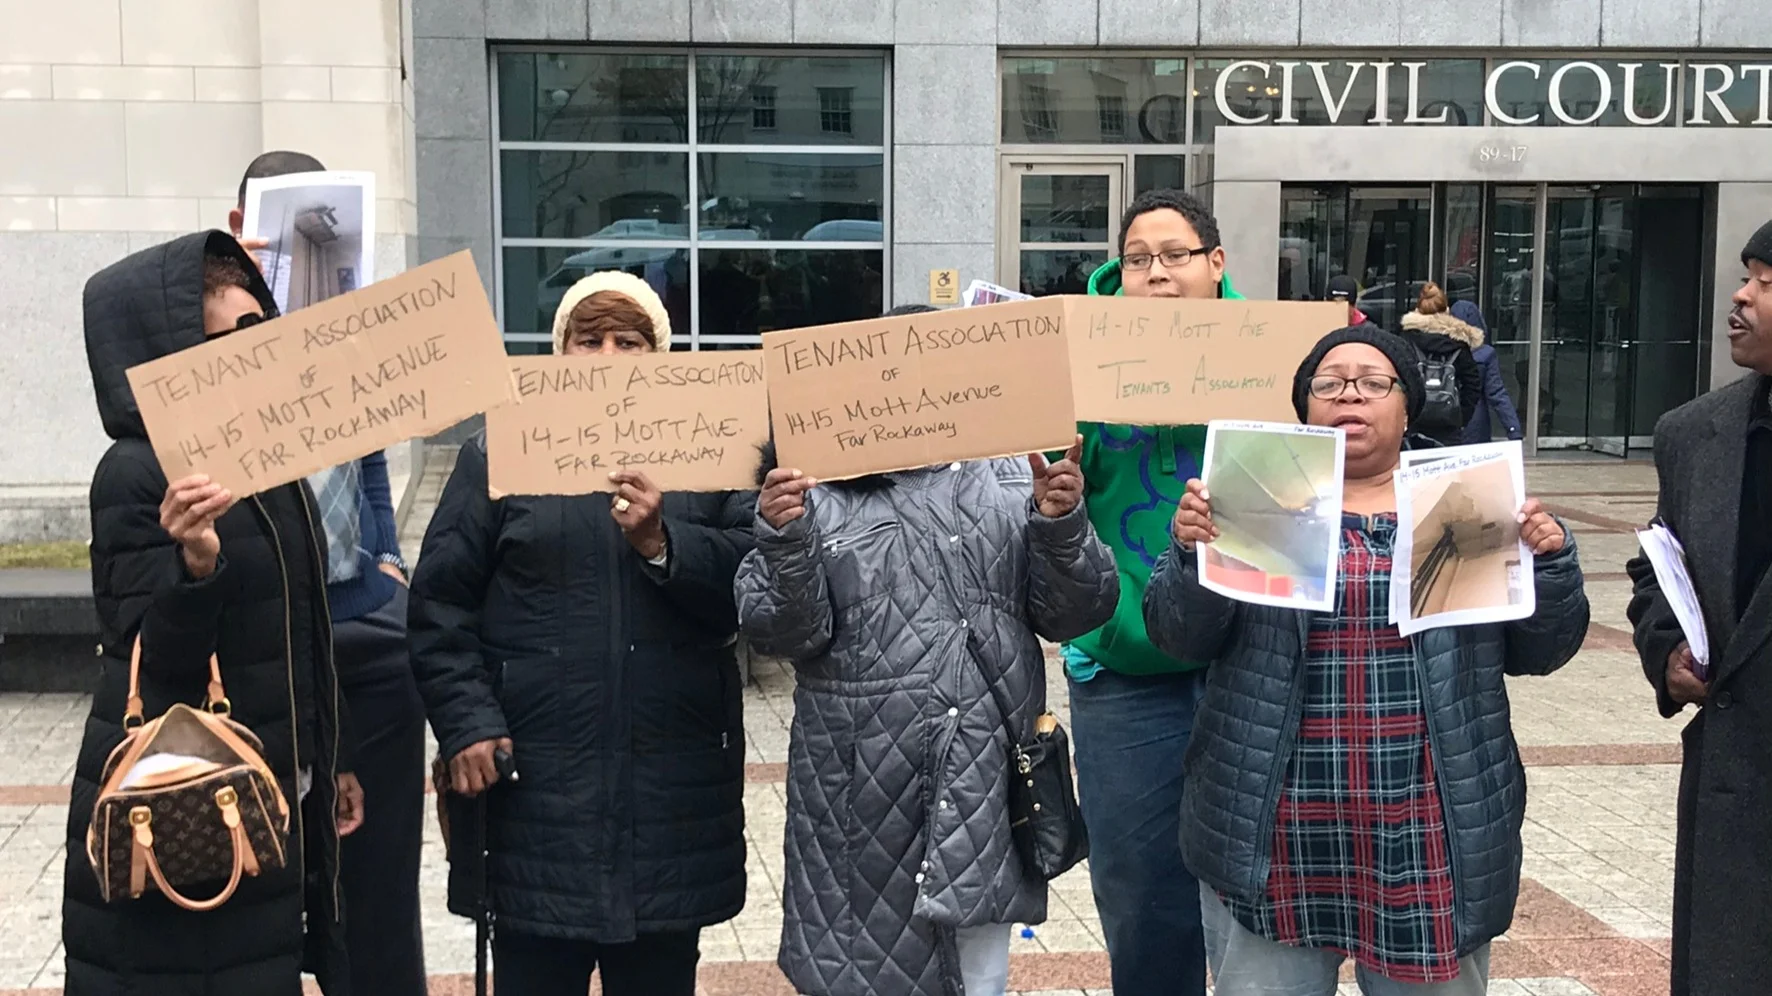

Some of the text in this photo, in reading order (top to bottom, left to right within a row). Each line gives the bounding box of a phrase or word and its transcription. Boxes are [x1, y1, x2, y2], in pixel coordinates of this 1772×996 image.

[1214, 61, 1772, 125] CIVIL COURT
[1479, 146, 1527, 161] 89-17
[141, 272, 456, 408] TENANT ASSOCIATION
[1088, 308, 1269, 340] 14-15 MOTT AVE
[773, 315, 1061, 374] TENANT ASSOCIATION
[301, 365, 318, 389] OF
[512, 365, 613, 397] ENANT
[881, 367, 900, 382] OF
[1097, 354, 1276, 400] TENANTS ASSOCIATION
[178, 334, 448, 467] 14-15 MOTT AVENUE
[606, 396, 637, 418] OF
[785, 382, 1003, 436] 14-15 Mott Avenue
[239, 389, 427, 479] FAR ROCKAWAY
[520, 423, 601, 455] 14-15
[614, 418, 687, 445] MOTT
[834, 420, 957, 451] Far Rockaway
[554, 446, 725, 476] FAR ROCKAWAY
